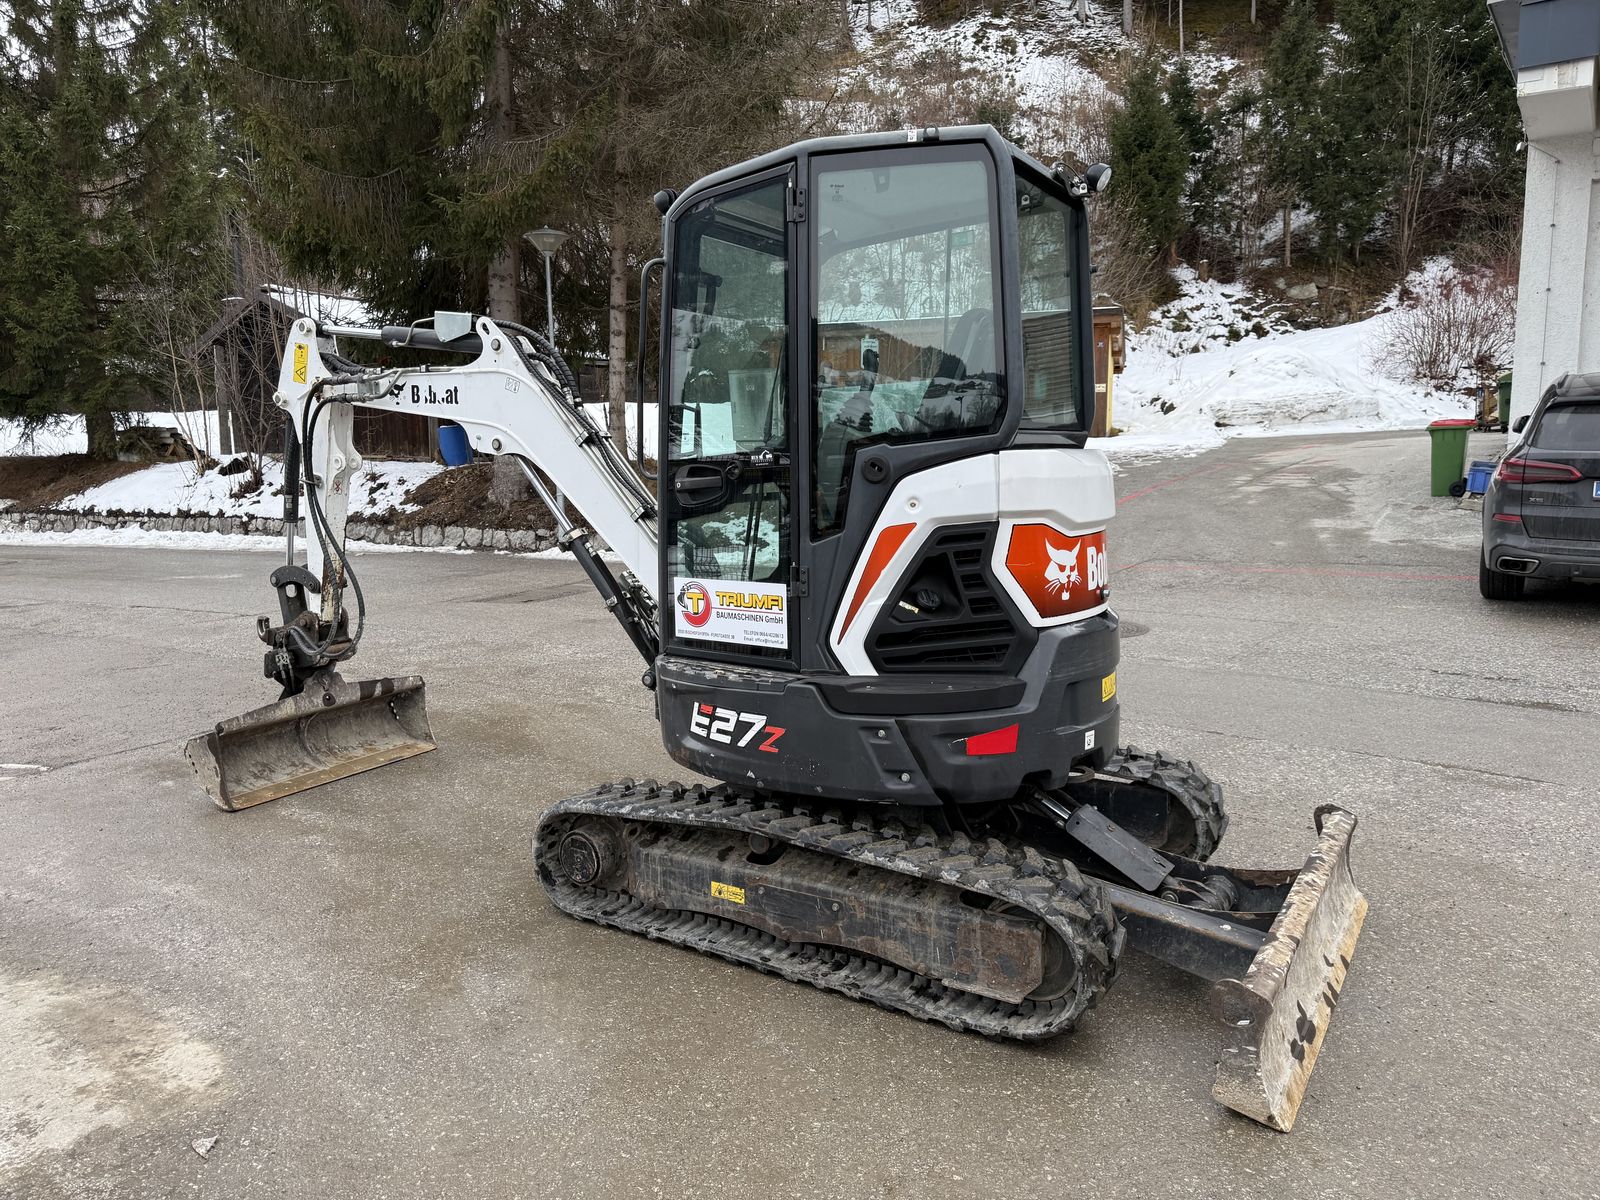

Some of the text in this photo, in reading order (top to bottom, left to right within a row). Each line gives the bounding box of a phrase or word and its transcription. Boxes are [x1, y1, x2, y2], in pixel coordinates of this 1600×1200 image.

[715, 591, 783, 611] TRIUMFI
[716, 611, 784, 625] BAUMASCHINEN GmbH
